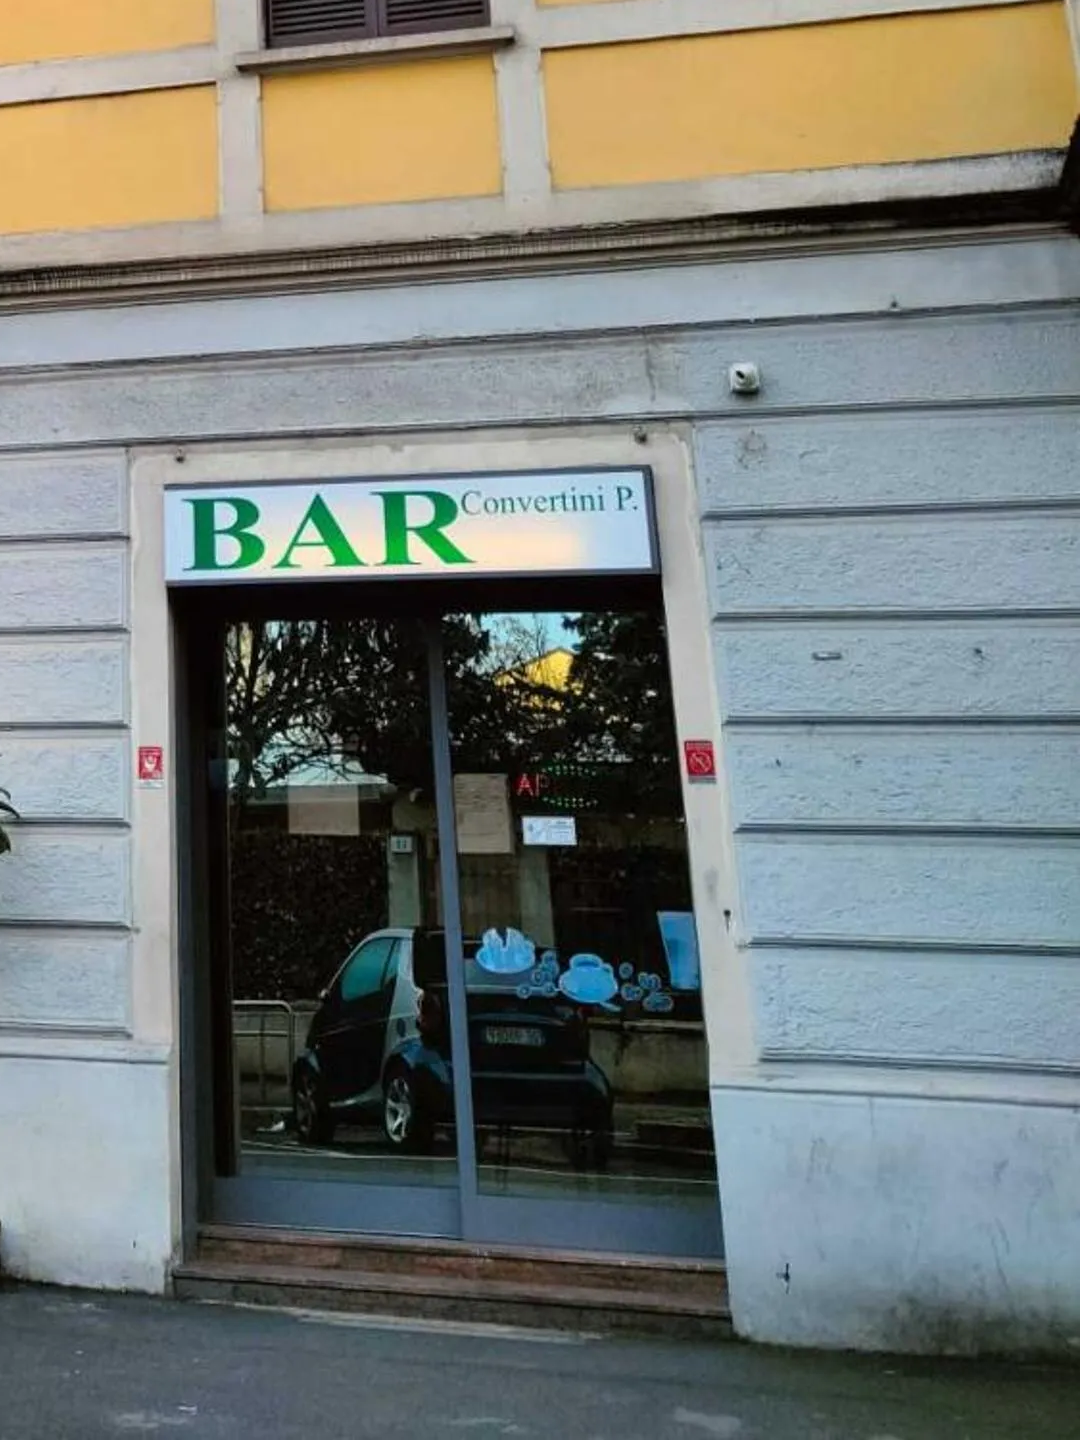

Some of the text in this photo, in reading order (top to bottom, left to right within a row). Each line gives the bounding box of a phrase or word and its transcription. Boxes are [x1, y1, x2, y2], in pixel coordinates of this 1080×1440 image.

[181, 486, 639, 572] BAR Convertini P.
